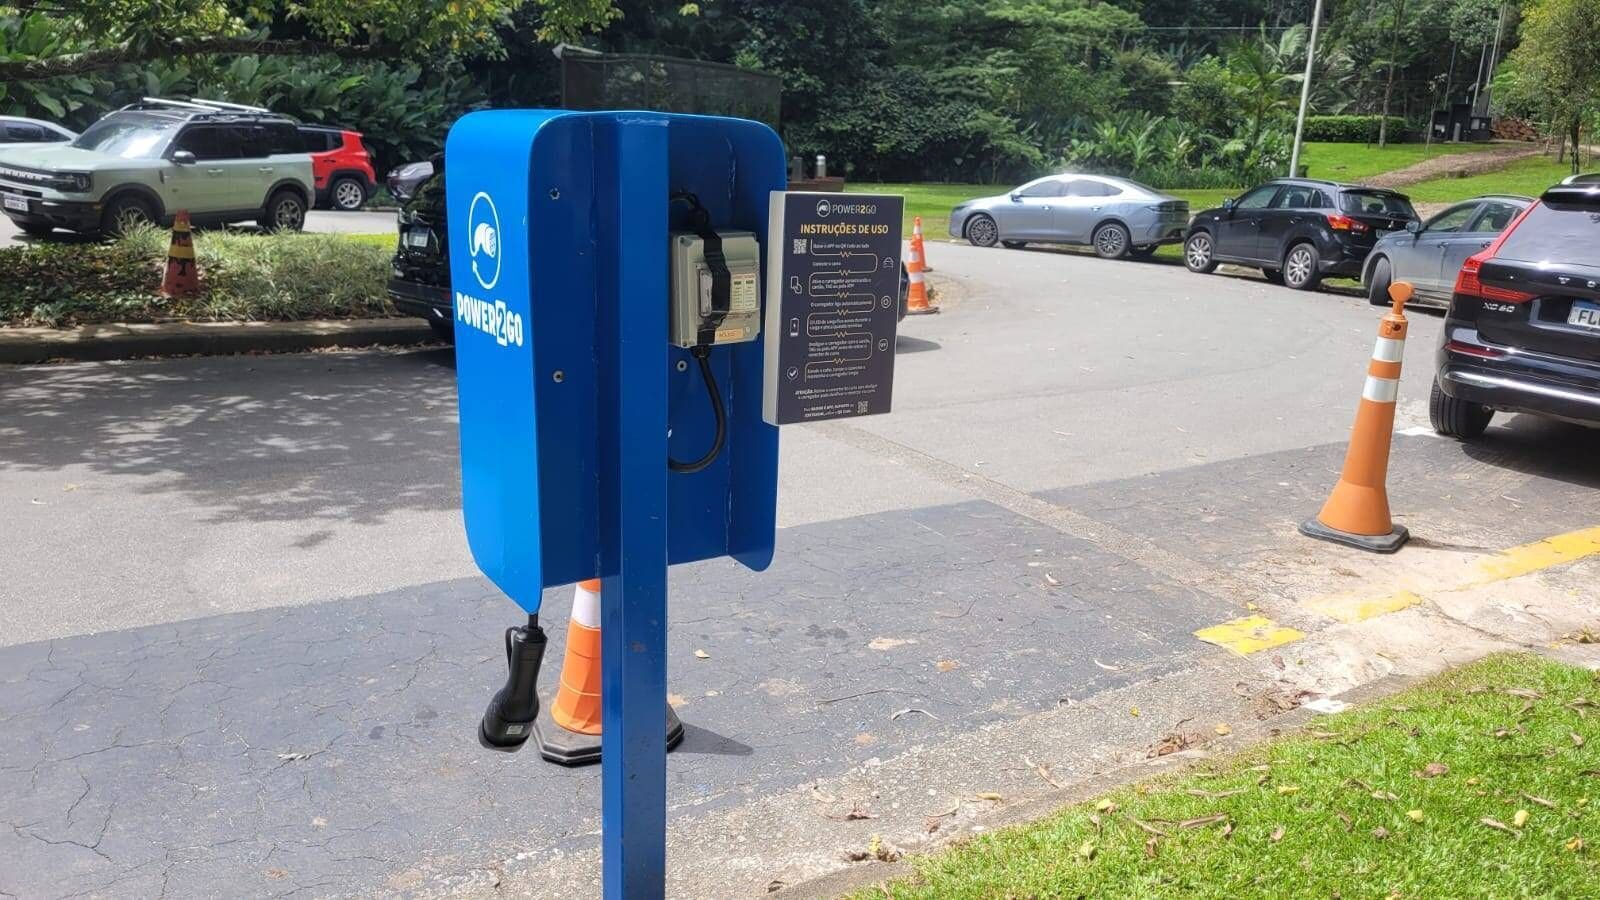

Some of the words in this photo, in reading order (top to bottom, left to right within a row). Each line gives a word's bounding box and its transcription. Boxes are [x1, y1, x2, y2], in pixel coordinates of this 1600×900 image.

[832, 204, 877, 215] POWER2GO
[800, 222, 857, 237] INSTRUÇÕES
[858, 224, 870, 234] DE
[871, 224, 889, 234] USO
[456, 291, 523, 346] POWER2GO
[1578, 309, 1600, 326] FL
